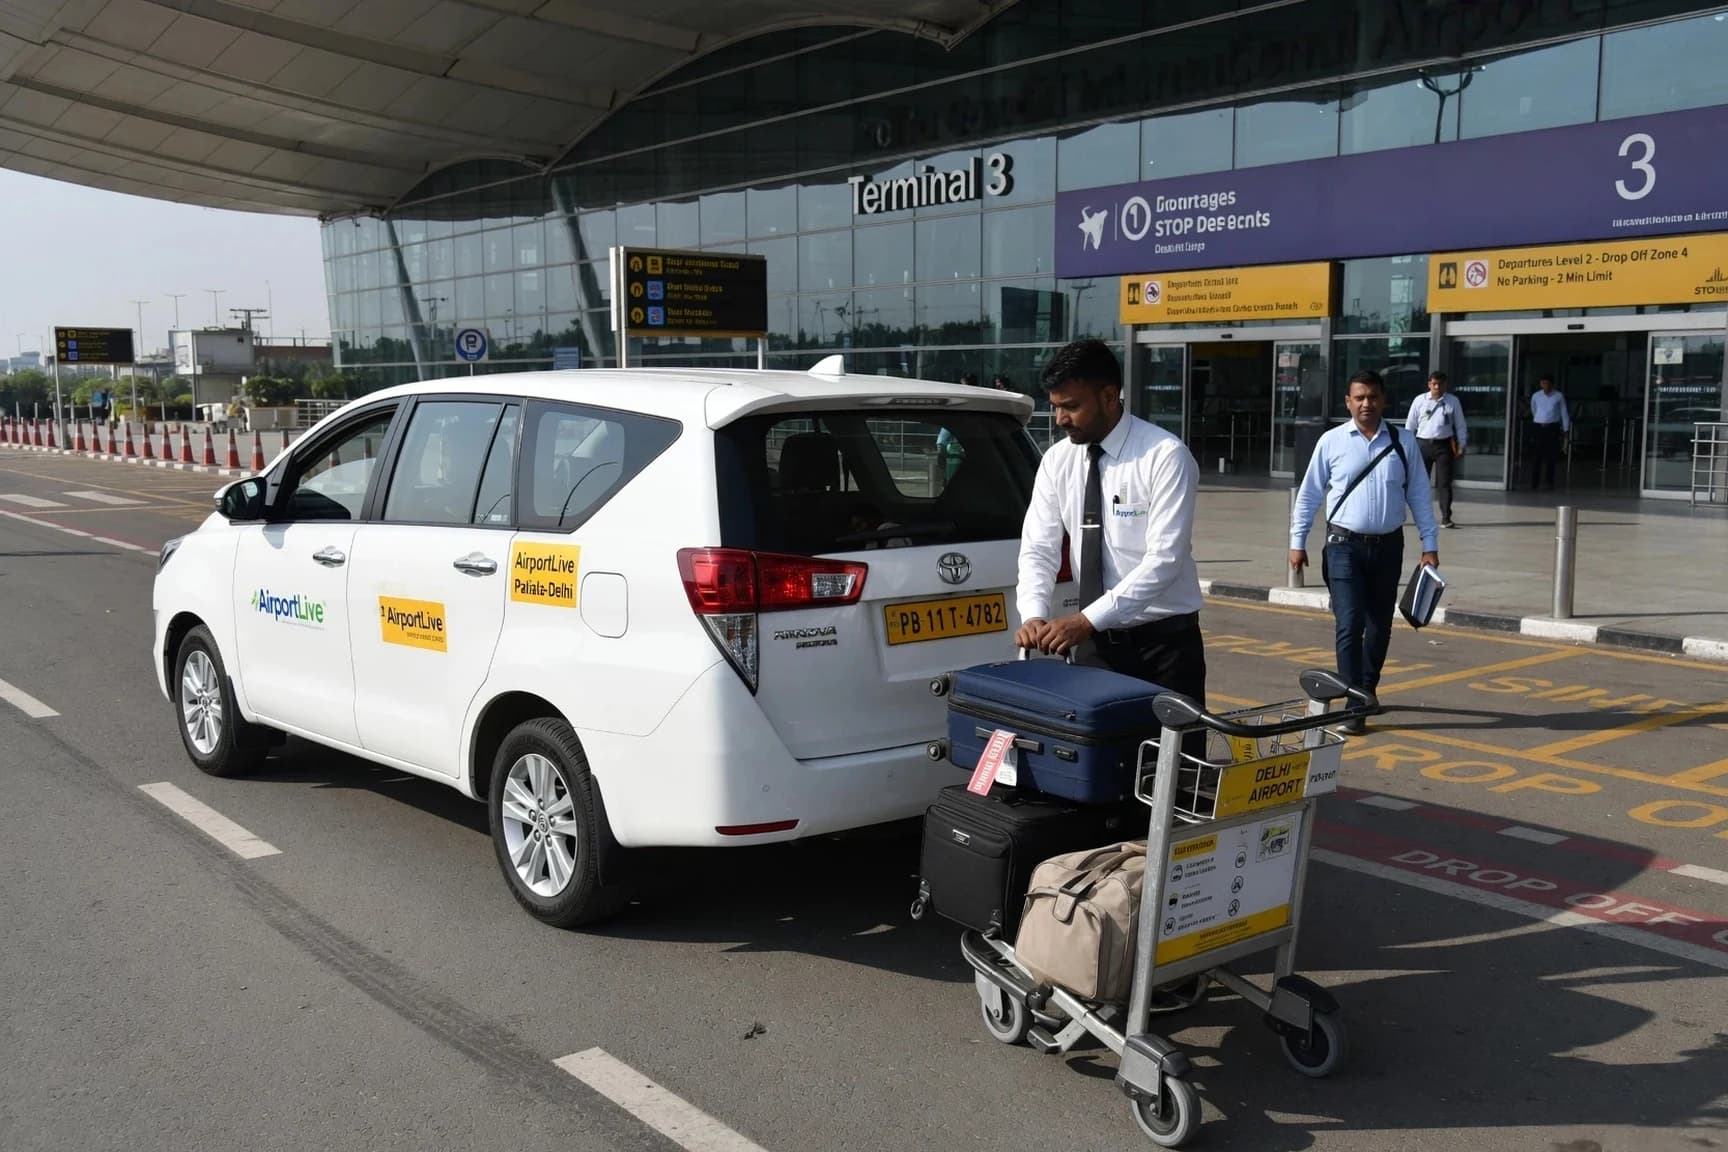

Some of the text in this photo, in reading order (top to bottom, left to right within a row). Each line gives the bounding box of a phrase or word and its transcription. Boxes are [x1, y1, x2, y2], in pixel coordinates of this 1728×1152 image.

[1615, 133, 1656, 201] 3
[848, 152, 1012, 215] Terminal 3
[1155, 217, 1193, 237] STOP
[1498, 258, 1553, 270] Departures
[1556, 254, 1583, 266] Level
[1586, 254, 1592, 264] 2
[1602, 252, 1628, 264] Drop
[1631, 250, 1648, 261] Off
[1651, 249, 1678, 260] Zone
[1681, 247, 1688, 258] 4
[1497, 276, 1510, 287] No
[1512, 274, 1549, 287] Parking
[1557, 273, 1563, 284] 2
[1566, 272, 1584, 283] Min
[1586, 271, 1613, 282] Limit
[515, 551, 574, 574] AirportLive
[259, 588, 324, 623] AirportLive
[387, 606, 443, 631] AirportLive
[900, 611, 921, 635] PB
[927, 607, 944, 632] 11
[966, 602, 1003, 627] 4782
[1256, 763, 1291, 783] DELHI
[1248, 778, 1304, 805] AIRPORT
[1391, 850, 1704, 926] DROP OFF
